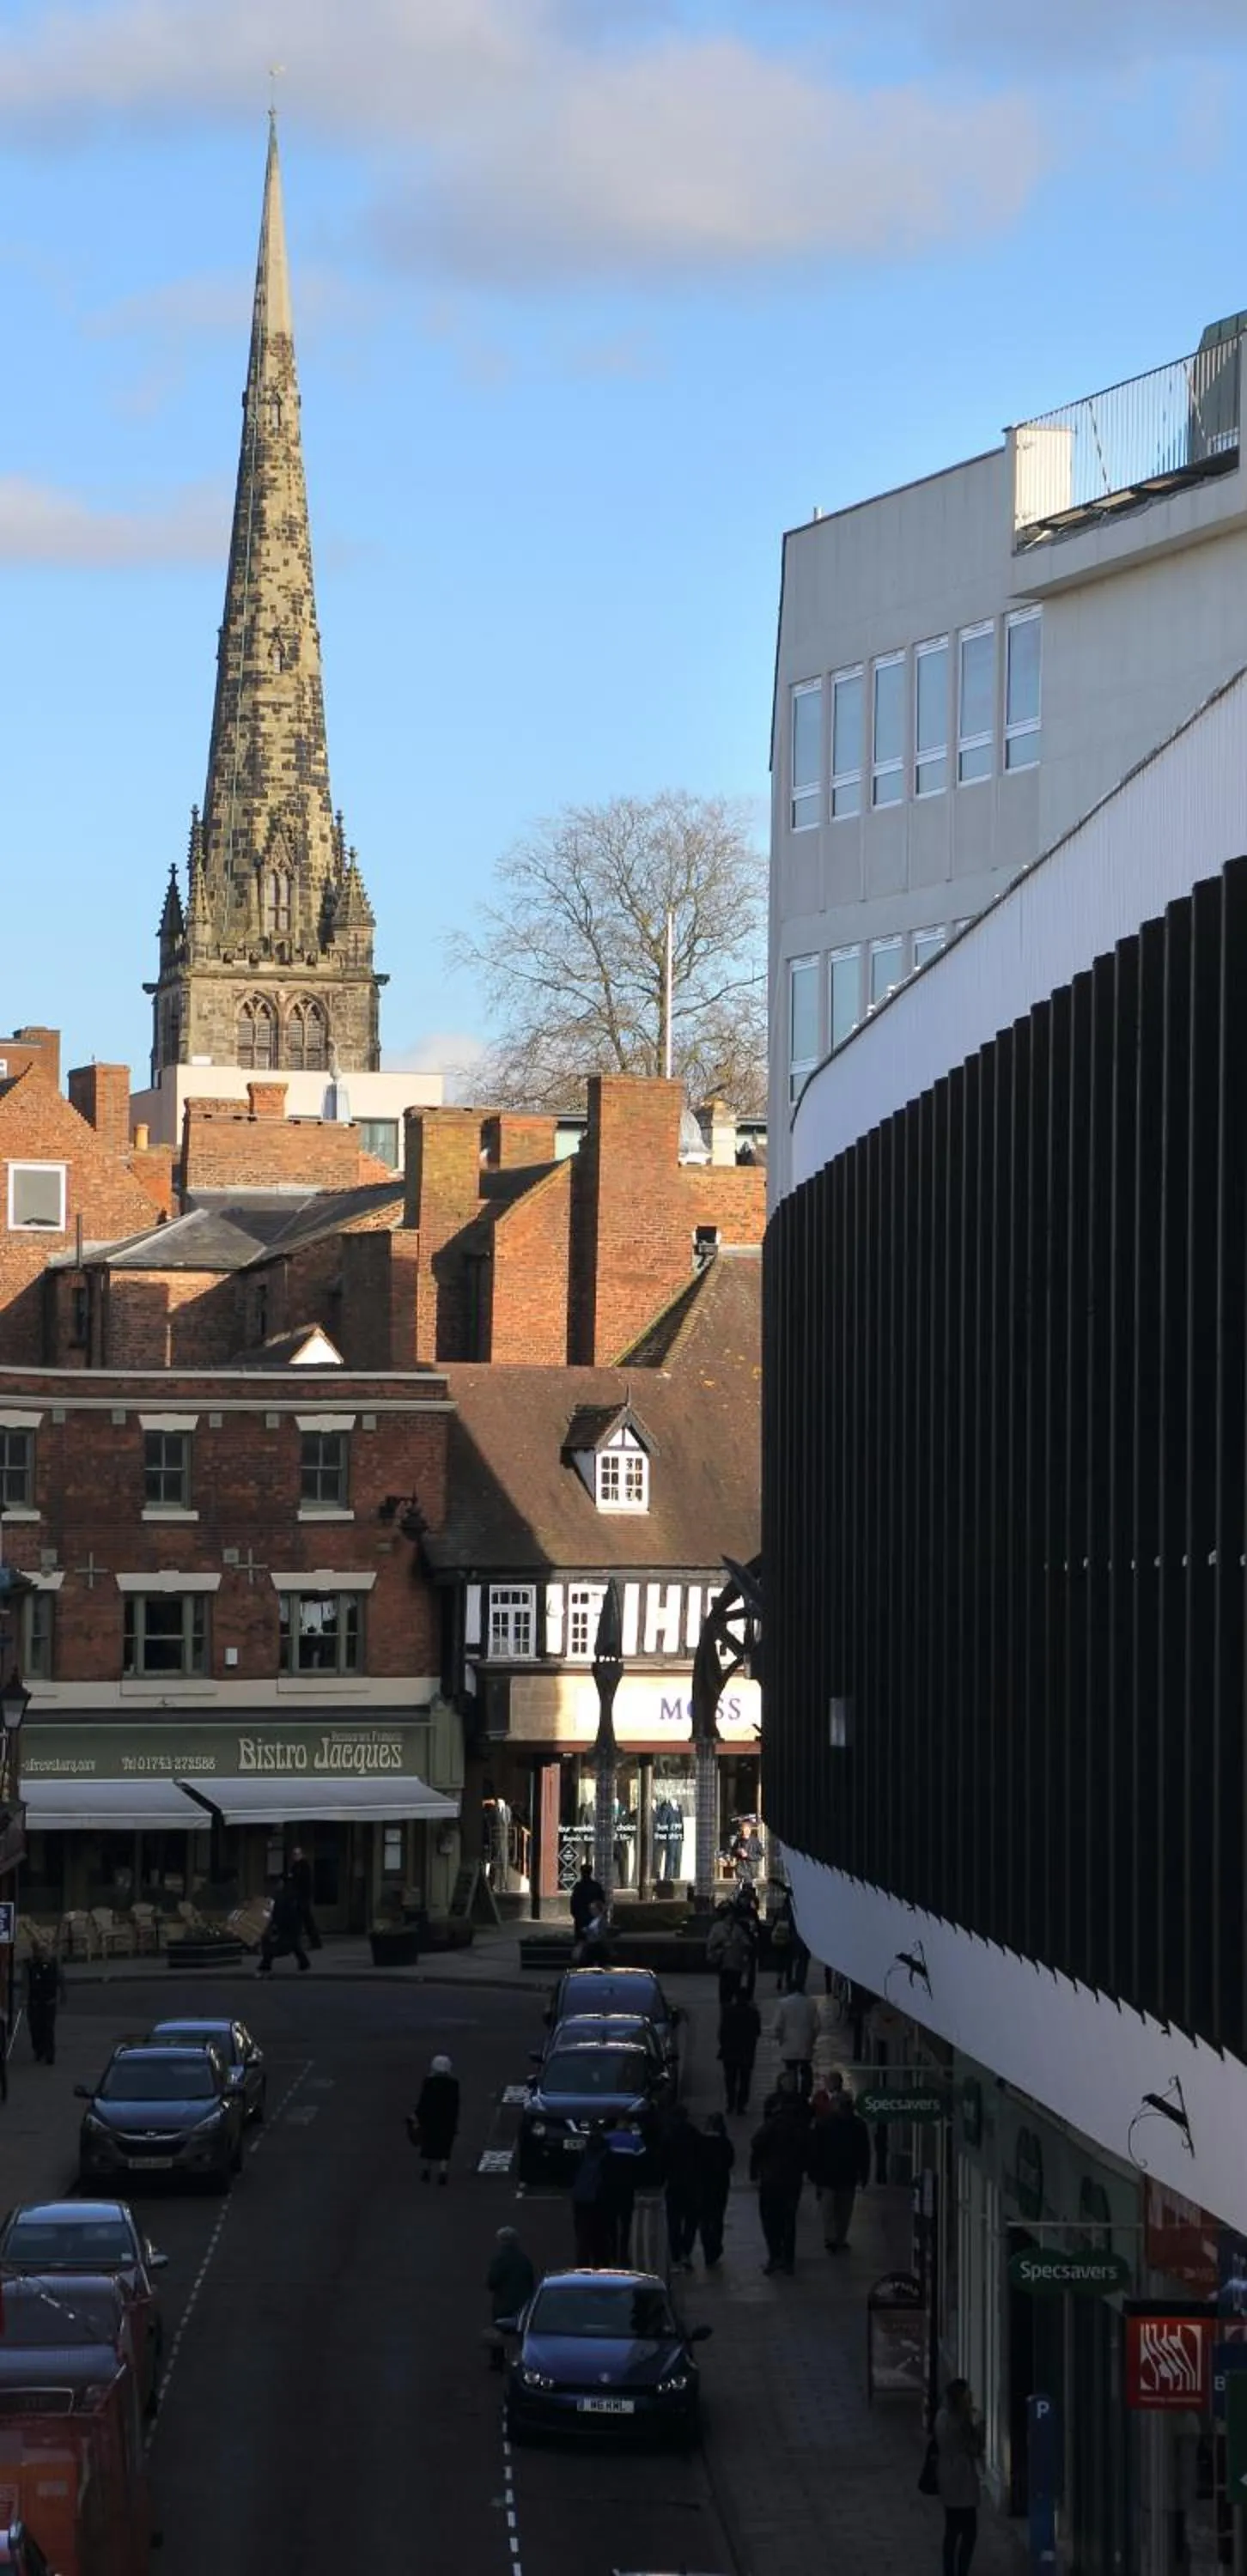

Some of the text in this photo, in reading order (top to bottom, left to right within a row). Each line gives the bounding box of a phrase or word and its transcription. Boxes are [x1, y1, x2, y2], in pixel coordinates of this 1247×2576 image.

[659, 1697, 741, 1721] MSS
[238, 1737, 403, 1775] Bistro Jacques
[864, 2096, 940, 2113] Specsavers
[1019, 2260, 1119, 2281] Specsavers
[1037, 2400, 1049, 2419] P
